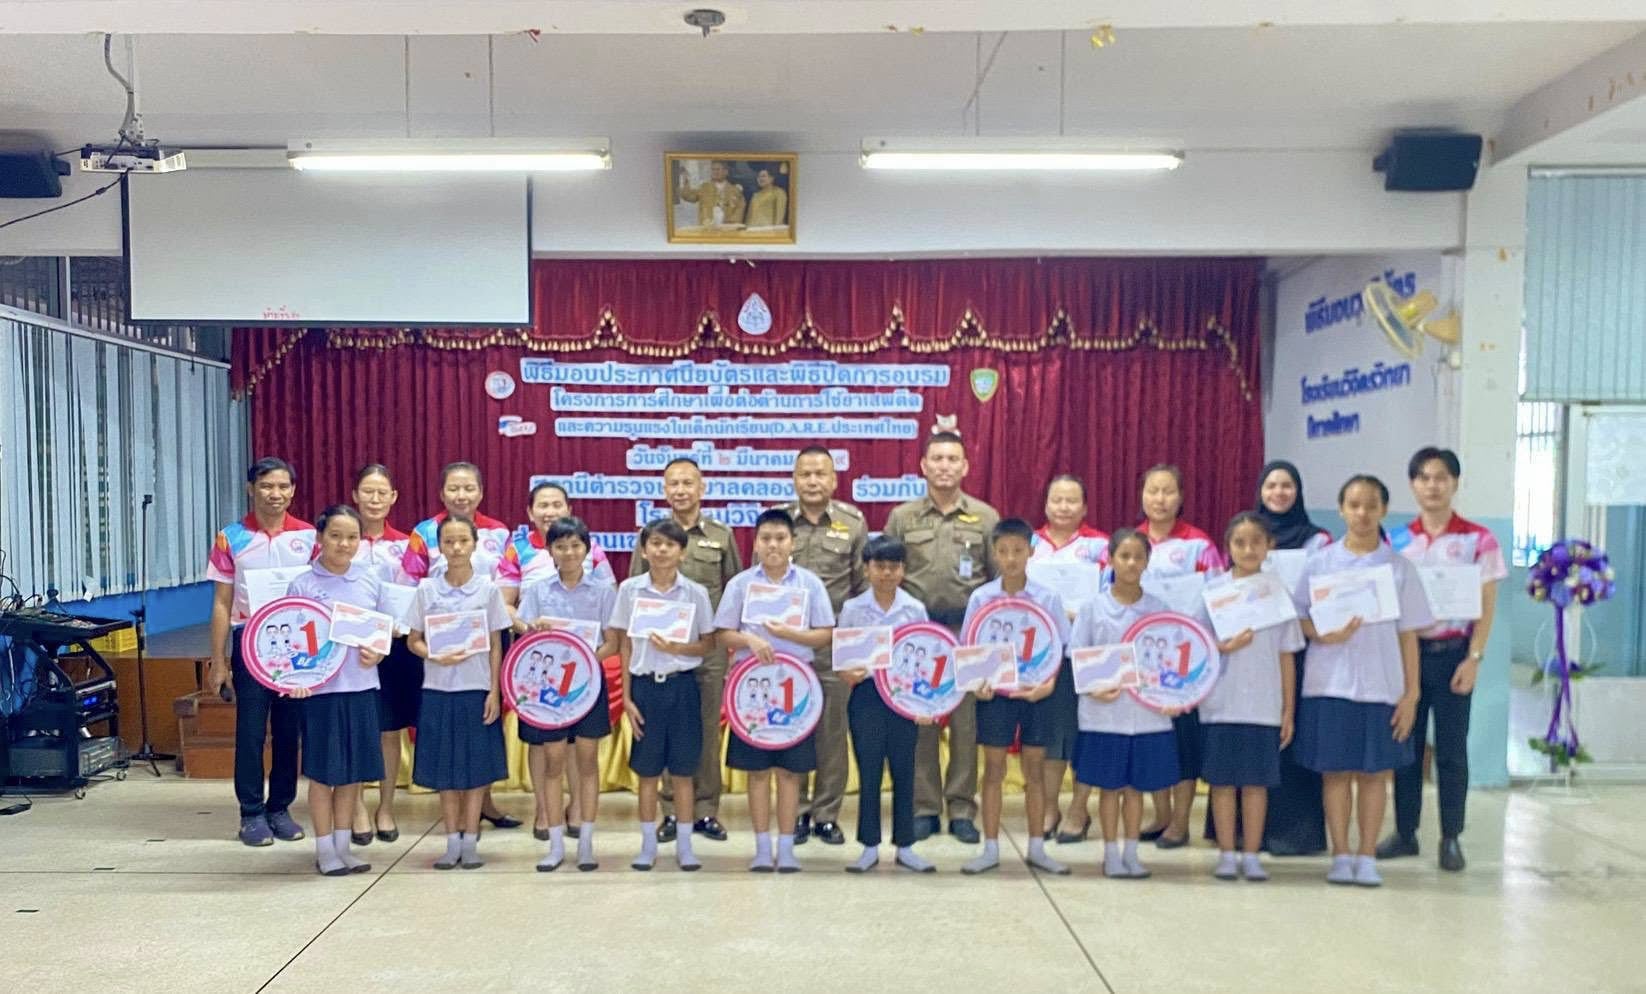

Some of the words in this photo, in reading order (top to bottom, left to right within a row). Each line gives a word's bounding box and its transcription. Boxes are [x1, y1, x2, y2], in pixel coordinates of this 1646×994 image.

[524, 360, 947, 385] พิธีมอบประกาศนียบัตรและพิธีปิดการอบรม
[554, 387, 920, 409] โครงการการศึกษาเพื่อต่อต้านการใช้ยาเสพติด
[856, 475, 926, 497] ร่วมกับ
[299, 620, 318, 657] 1
[1019, 626, 1036, 662] 1
[932, 655, 947, 688] 1
[1175, 640, 1191, 676] 1
[560, 660, 577, 698] 1
[778, 676, 793, 714] 1
